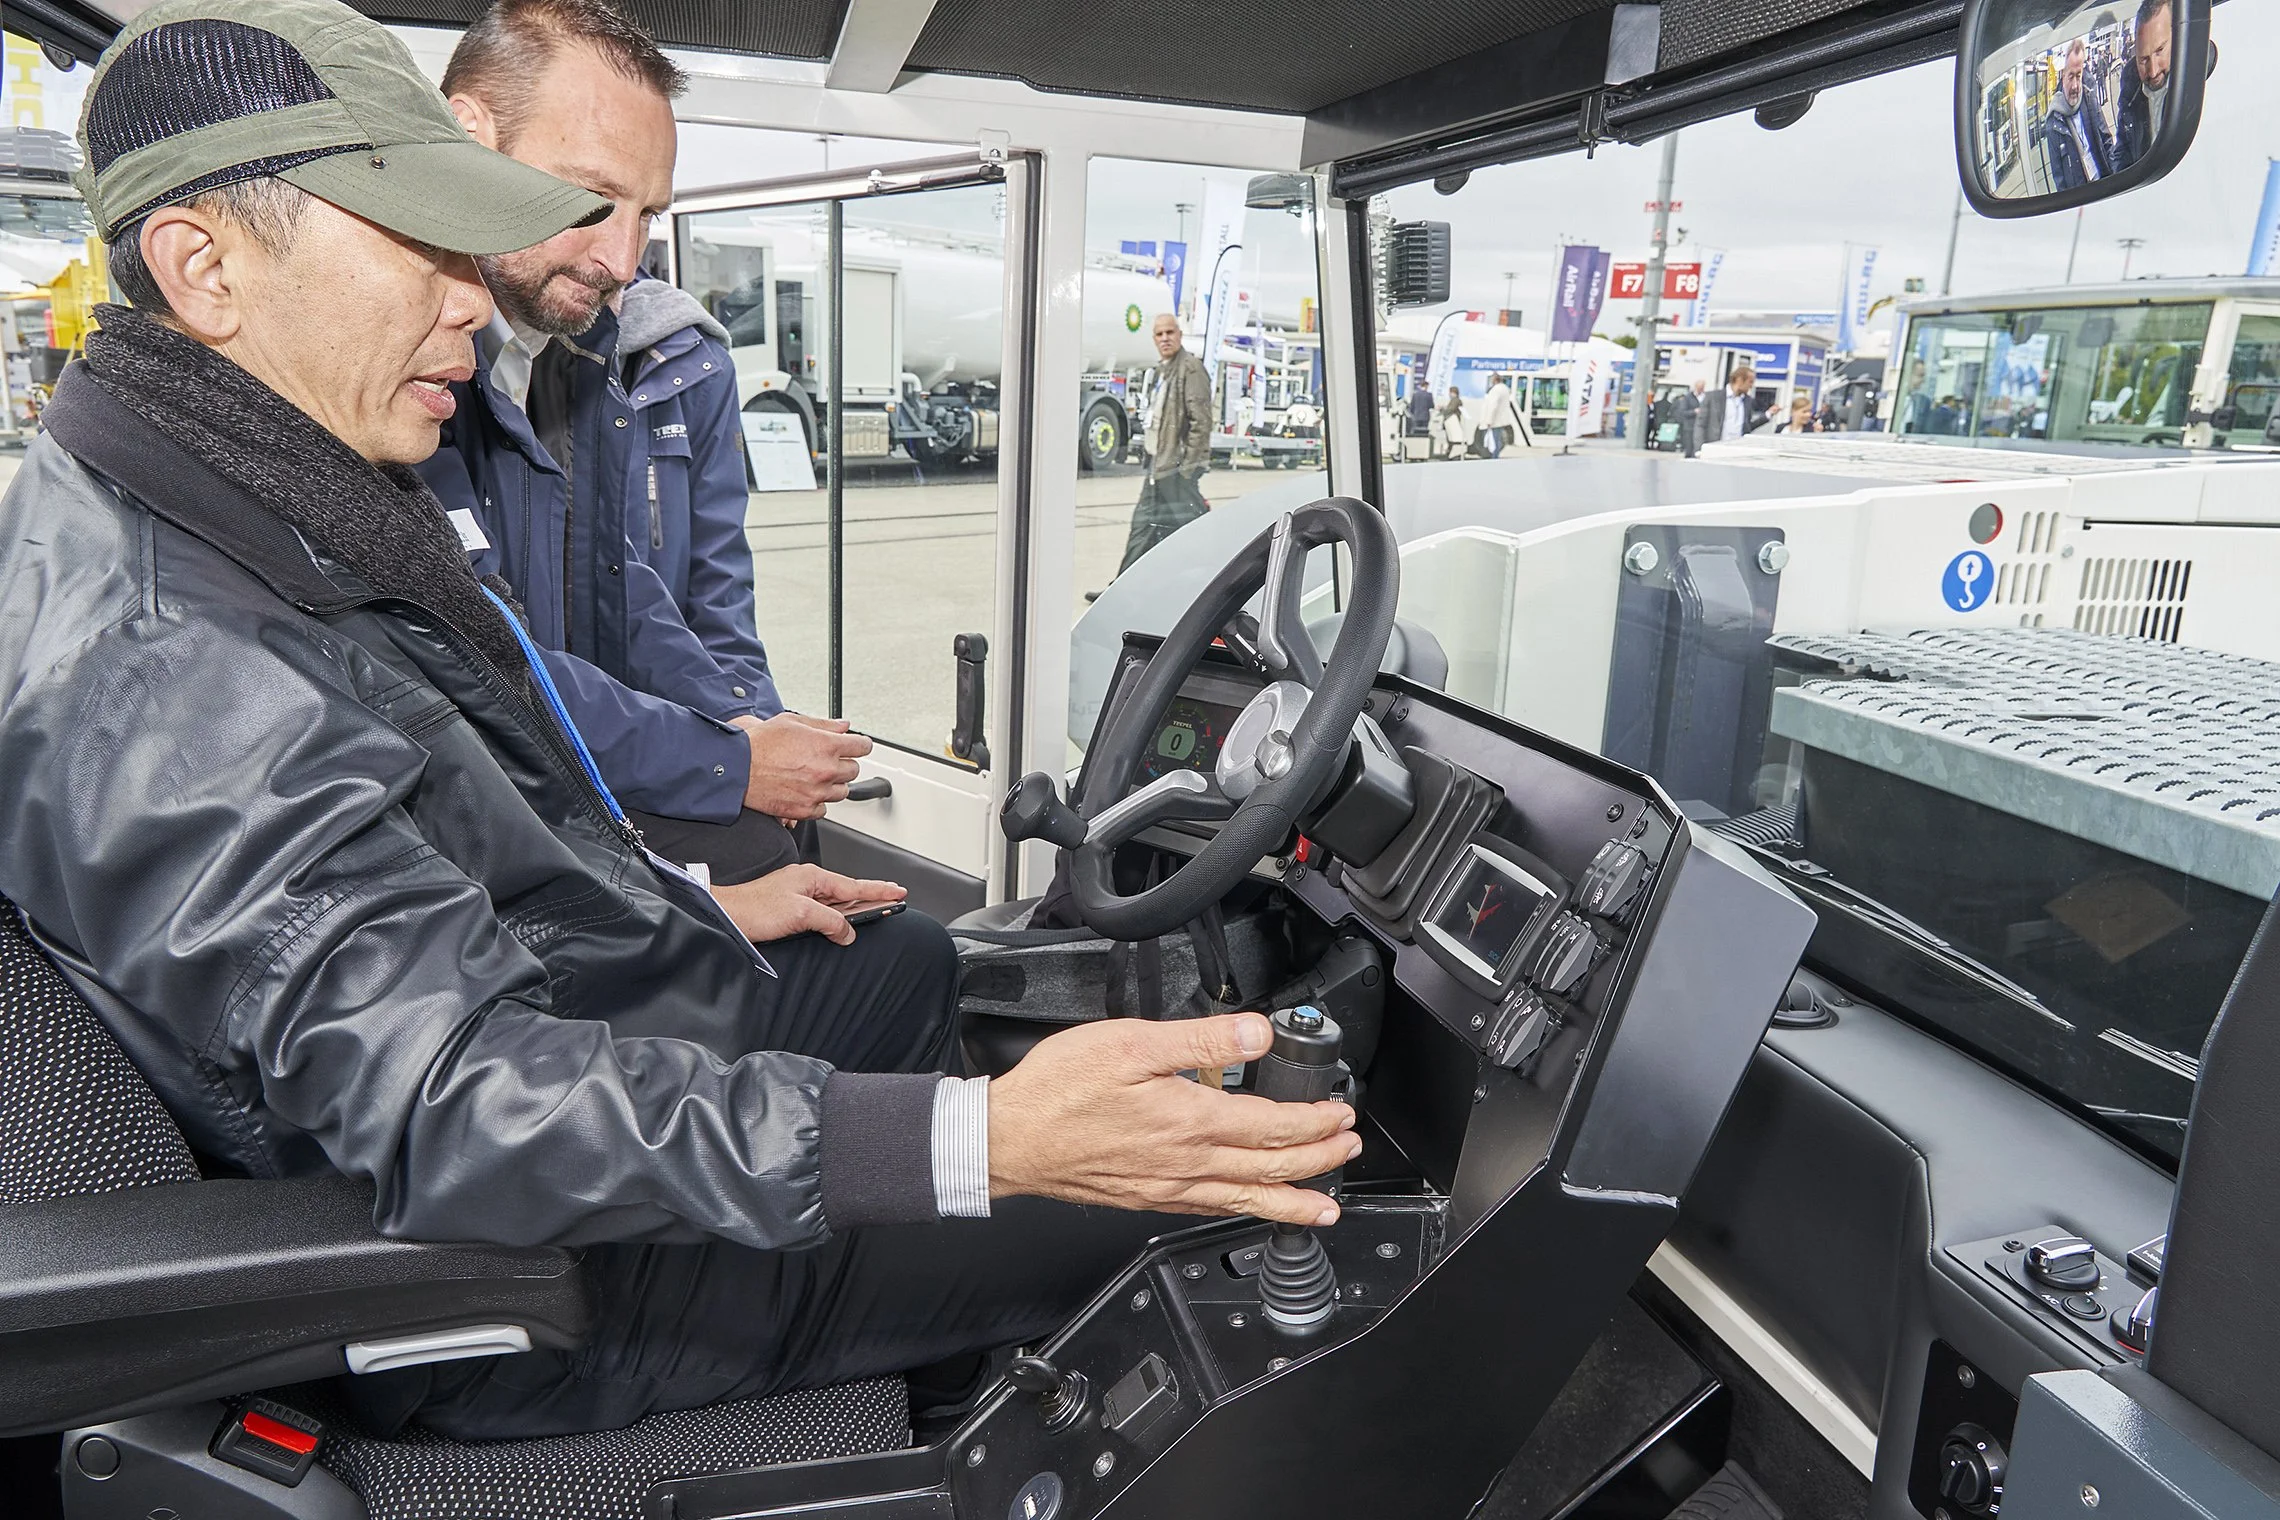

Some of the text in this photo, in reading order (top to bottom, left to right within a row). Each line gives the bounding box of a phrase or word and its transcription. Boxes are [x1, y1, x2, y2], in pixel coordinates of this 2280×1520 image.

[1563, 264, 1580, 308] AirRail
[1621, 273, 1644, 293] F7
[1675, 273, 1698, 293] F8
[1471, 359, 1506, 370] Partners
[1519, 360, 1545, 371] Europ
[653, 424, 687, 437] TREP
[1173, 720, 1193, 729] TREPEL
[1171, 733, 1182, 751] 0
[2041, 1293, 2060, 1305] A/C
[1977, 1442, 1986, 1450] 0
